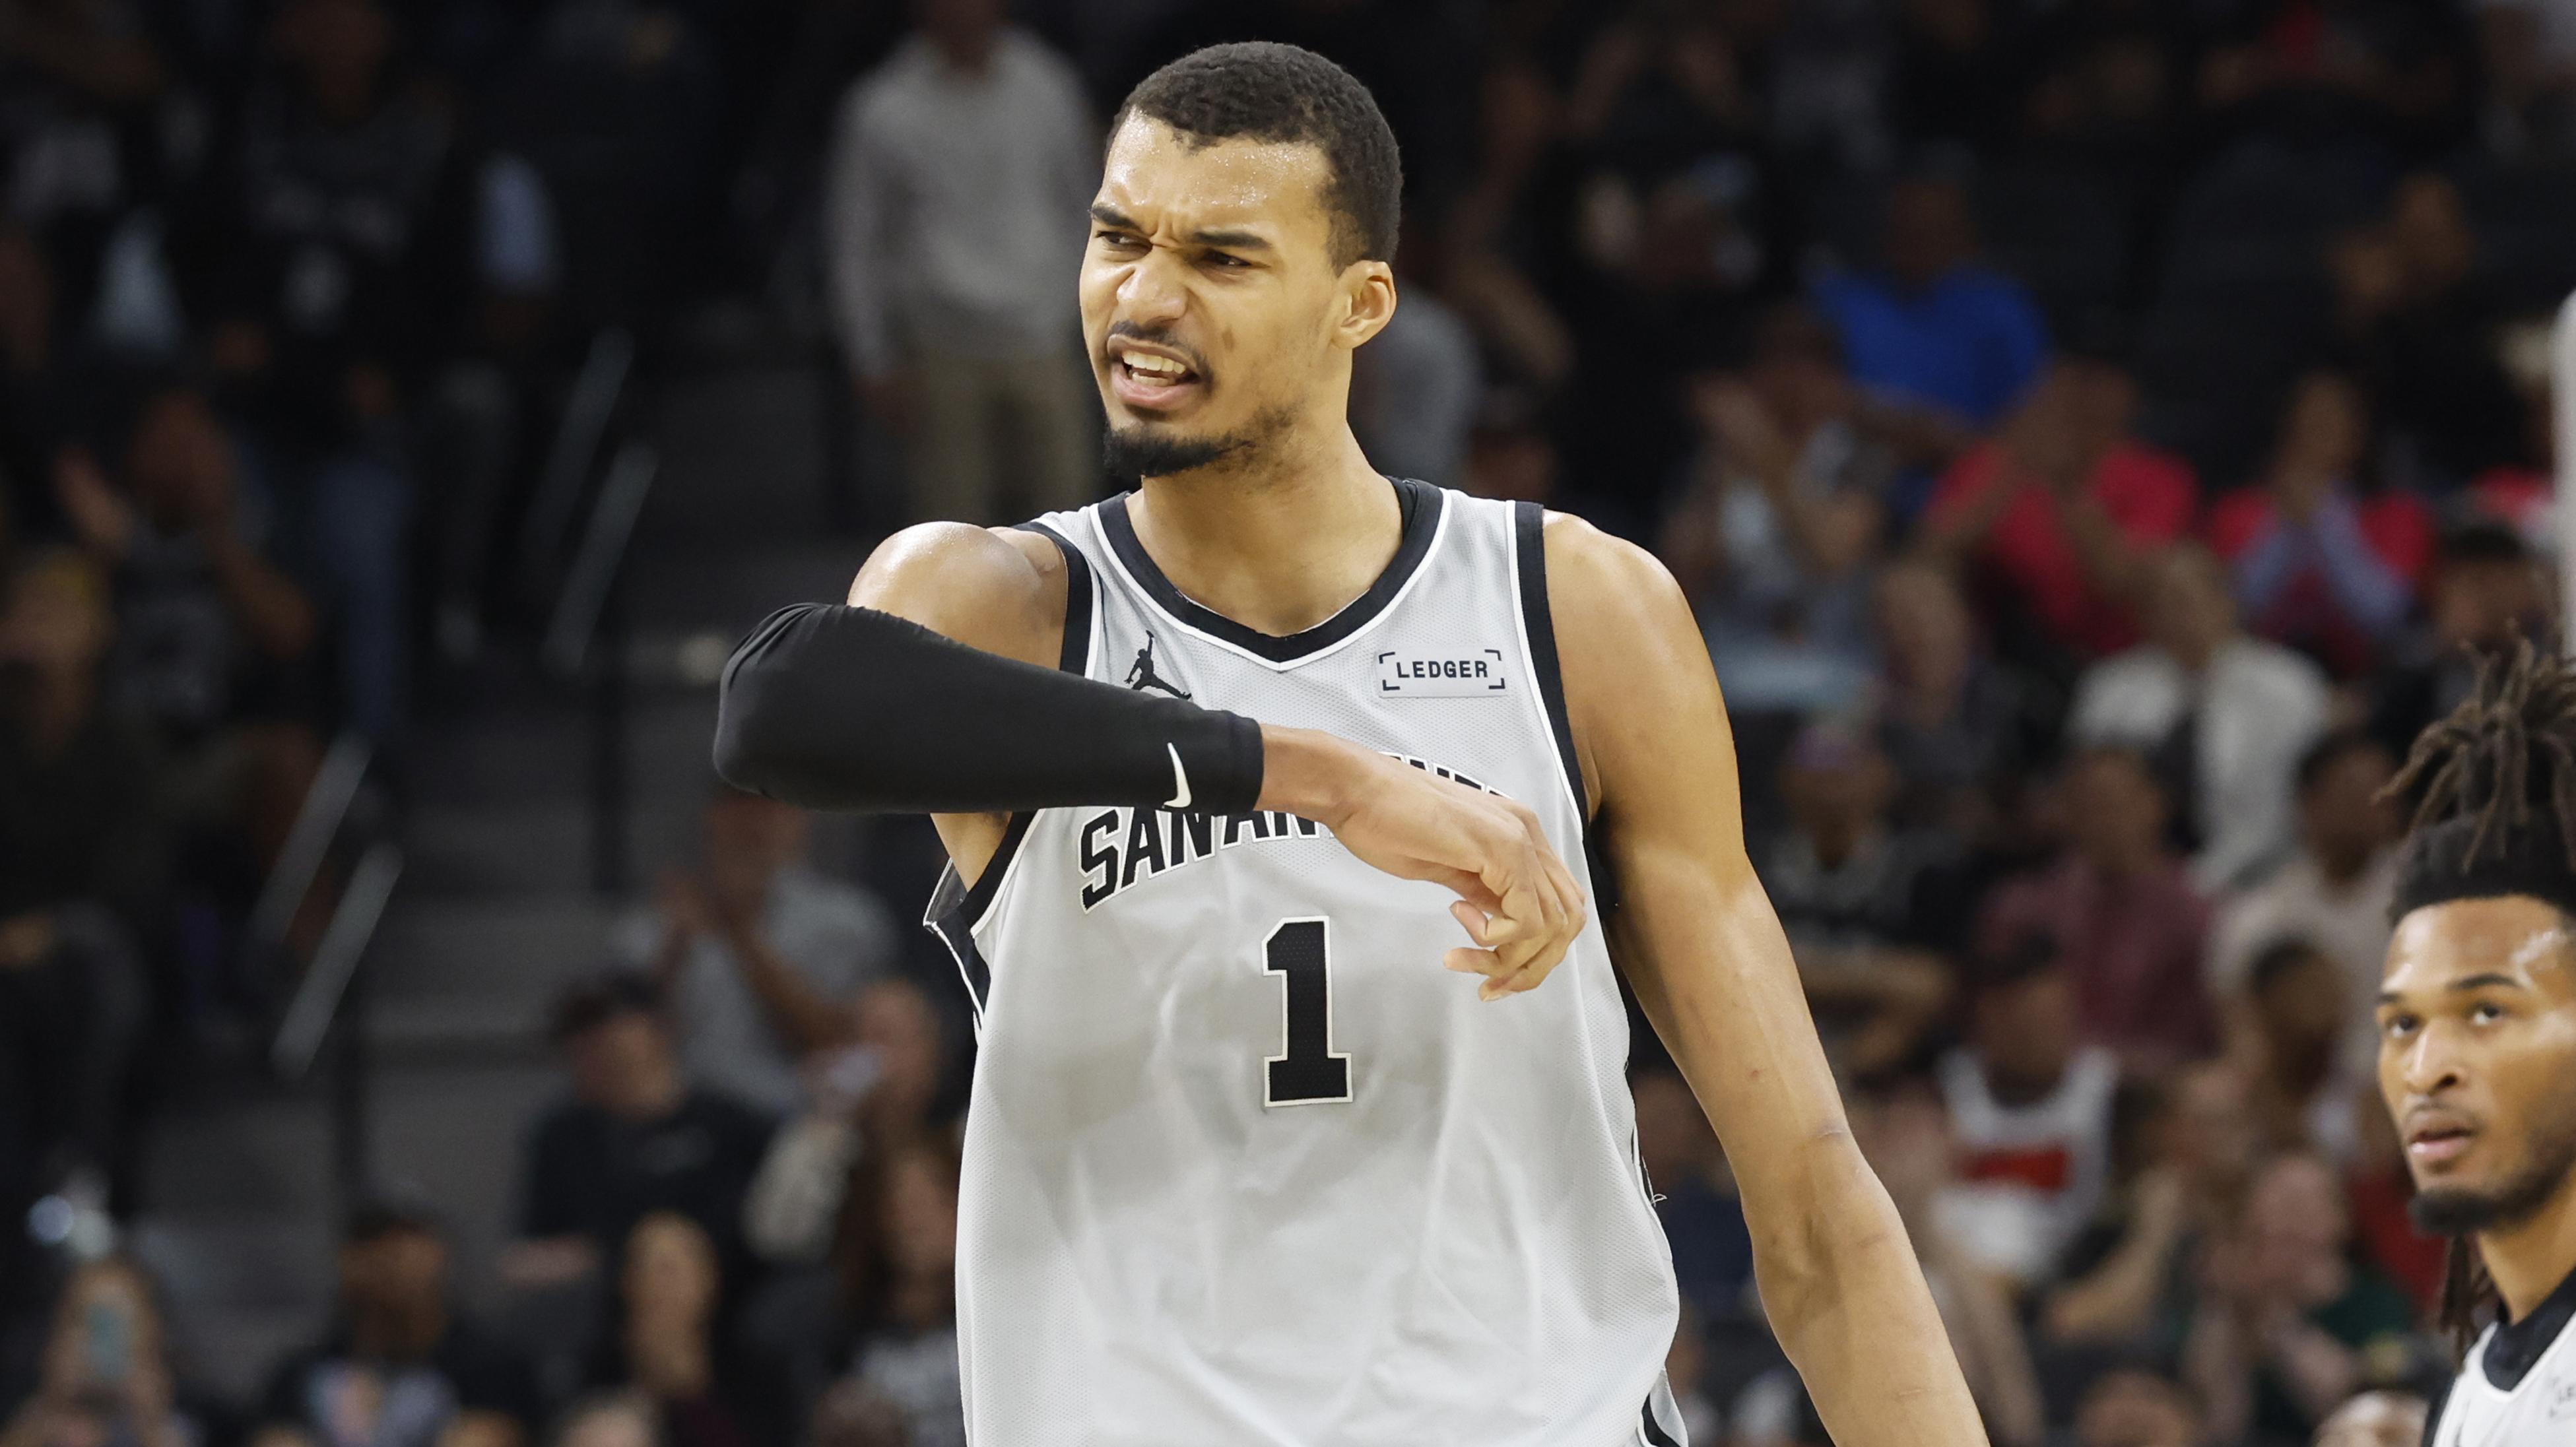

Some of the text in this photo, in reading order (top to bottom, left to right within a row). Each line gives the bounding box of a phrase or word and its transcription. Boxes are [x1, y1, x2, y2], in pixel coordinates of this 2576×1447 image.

[1396, 660, 1488, 678] LEDGER
[1078, 806, 1215, 915] SAN
[1261, 915, 1353, 1107] 1
